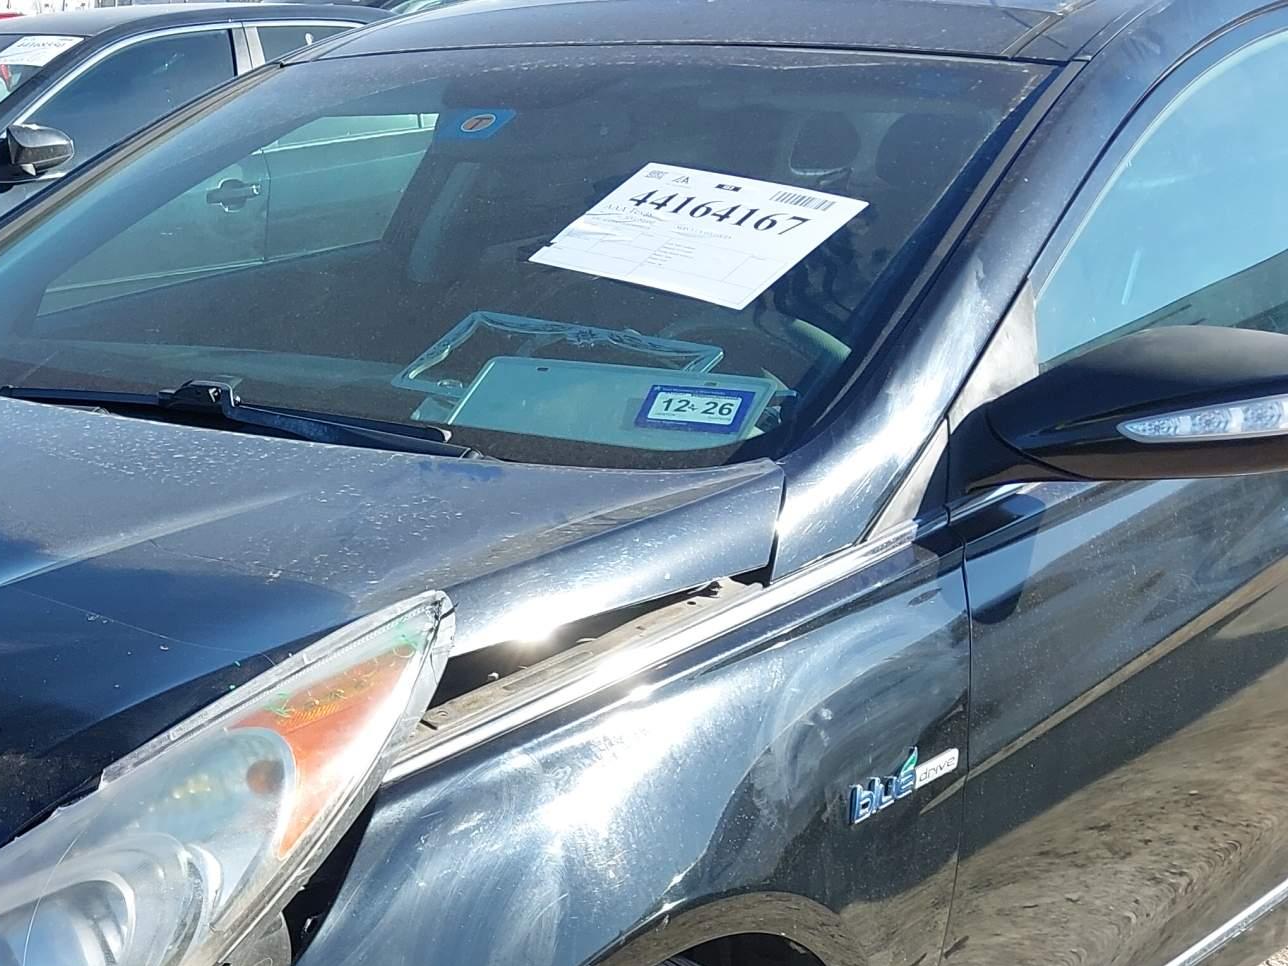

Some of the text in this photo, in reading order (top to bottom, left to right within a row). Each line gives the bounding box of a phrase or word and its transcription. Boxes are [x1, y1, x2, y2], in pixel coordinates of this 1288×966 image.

[628, 190, 813, 235] 44164167
[662, 398, 734, 416] 12 26
[919, 755, 956, 782] drive
